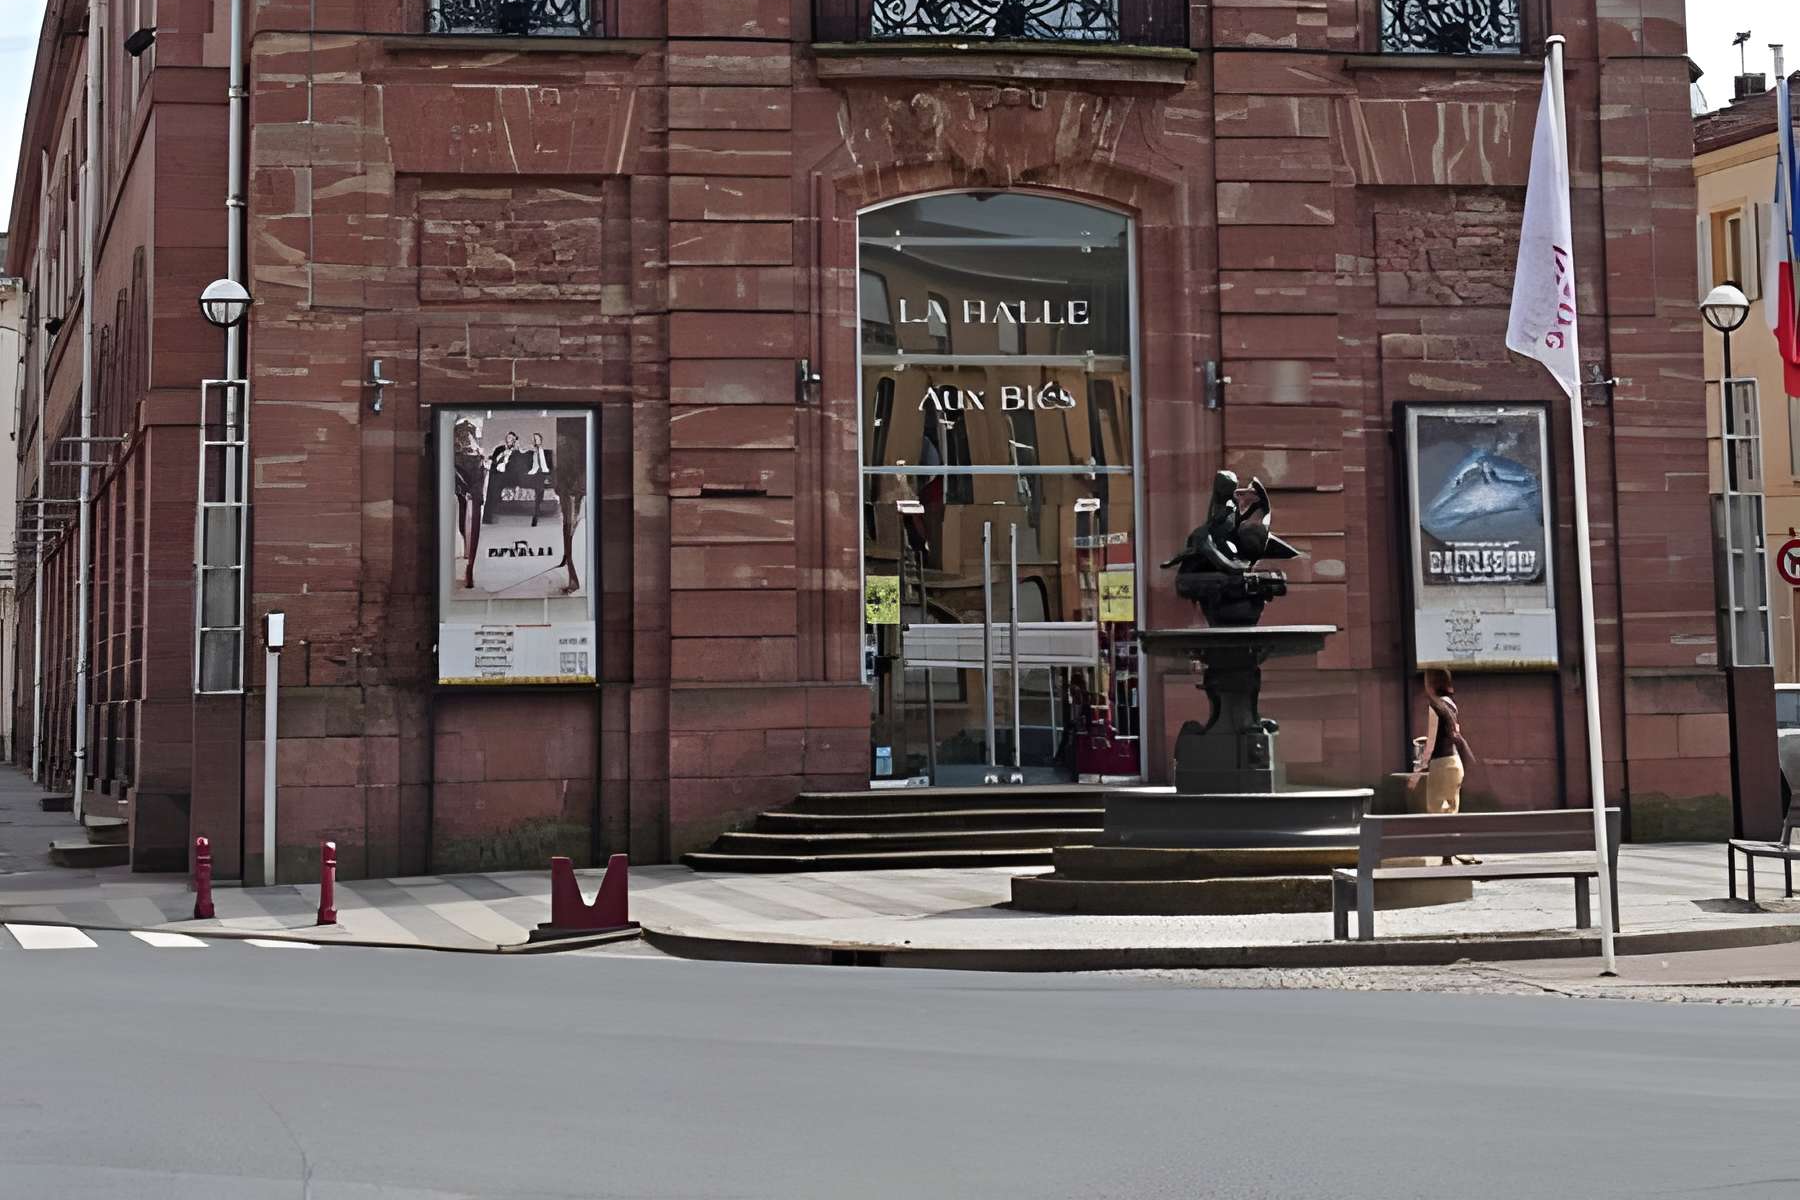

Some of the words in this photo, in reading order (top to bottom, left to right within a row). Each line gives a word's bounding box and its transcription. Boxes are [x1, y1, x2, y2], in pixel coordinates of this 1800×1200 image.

[900, 299, 948, 324] LA
[963, 299, 1090, 325] HALLE
[918, 386, 985, 411] AUX
